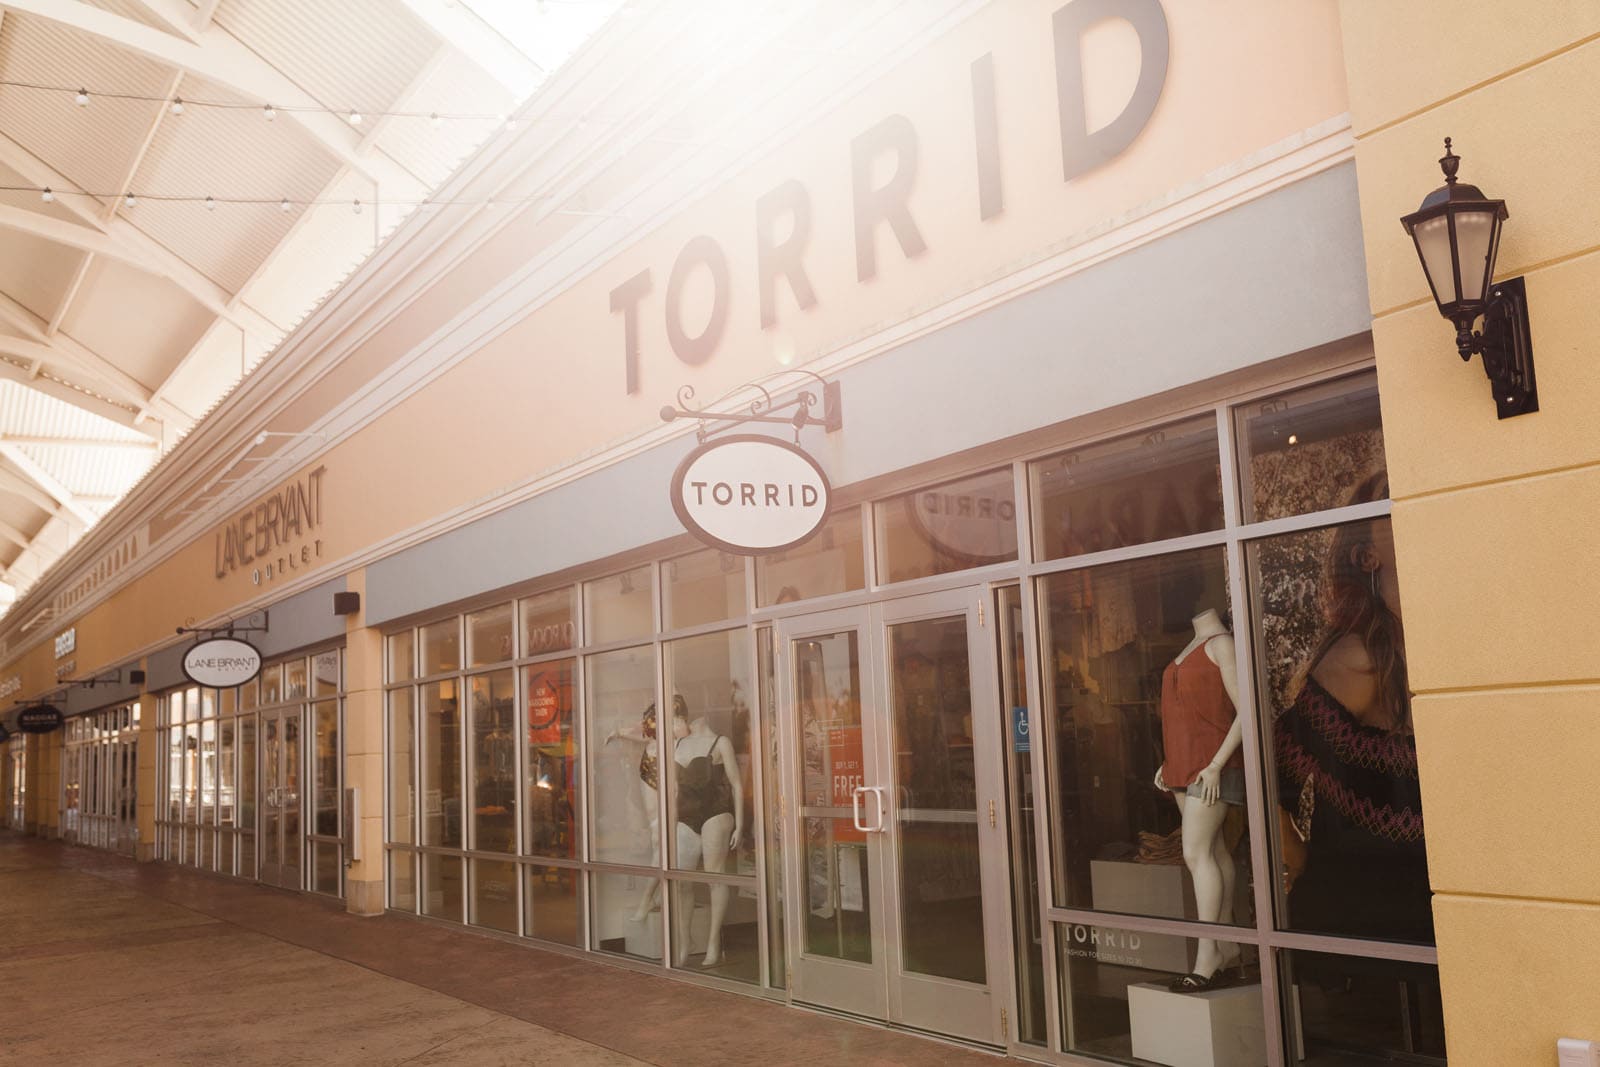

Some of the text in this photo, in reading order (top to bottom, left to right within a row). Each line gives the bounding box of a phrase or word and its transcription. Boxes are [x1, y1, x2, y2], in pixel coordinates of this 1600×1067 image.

[609, 0, 1170, 396] TORRID
[691, 481, 819, 507] TORRID
[252, 540, 322, 585] OUTLET
[188, 657, 257, 670] LANE BRYANT
[834, 775, 862, 797] FREE
[1062, 923, 1141, 950] TORRID
